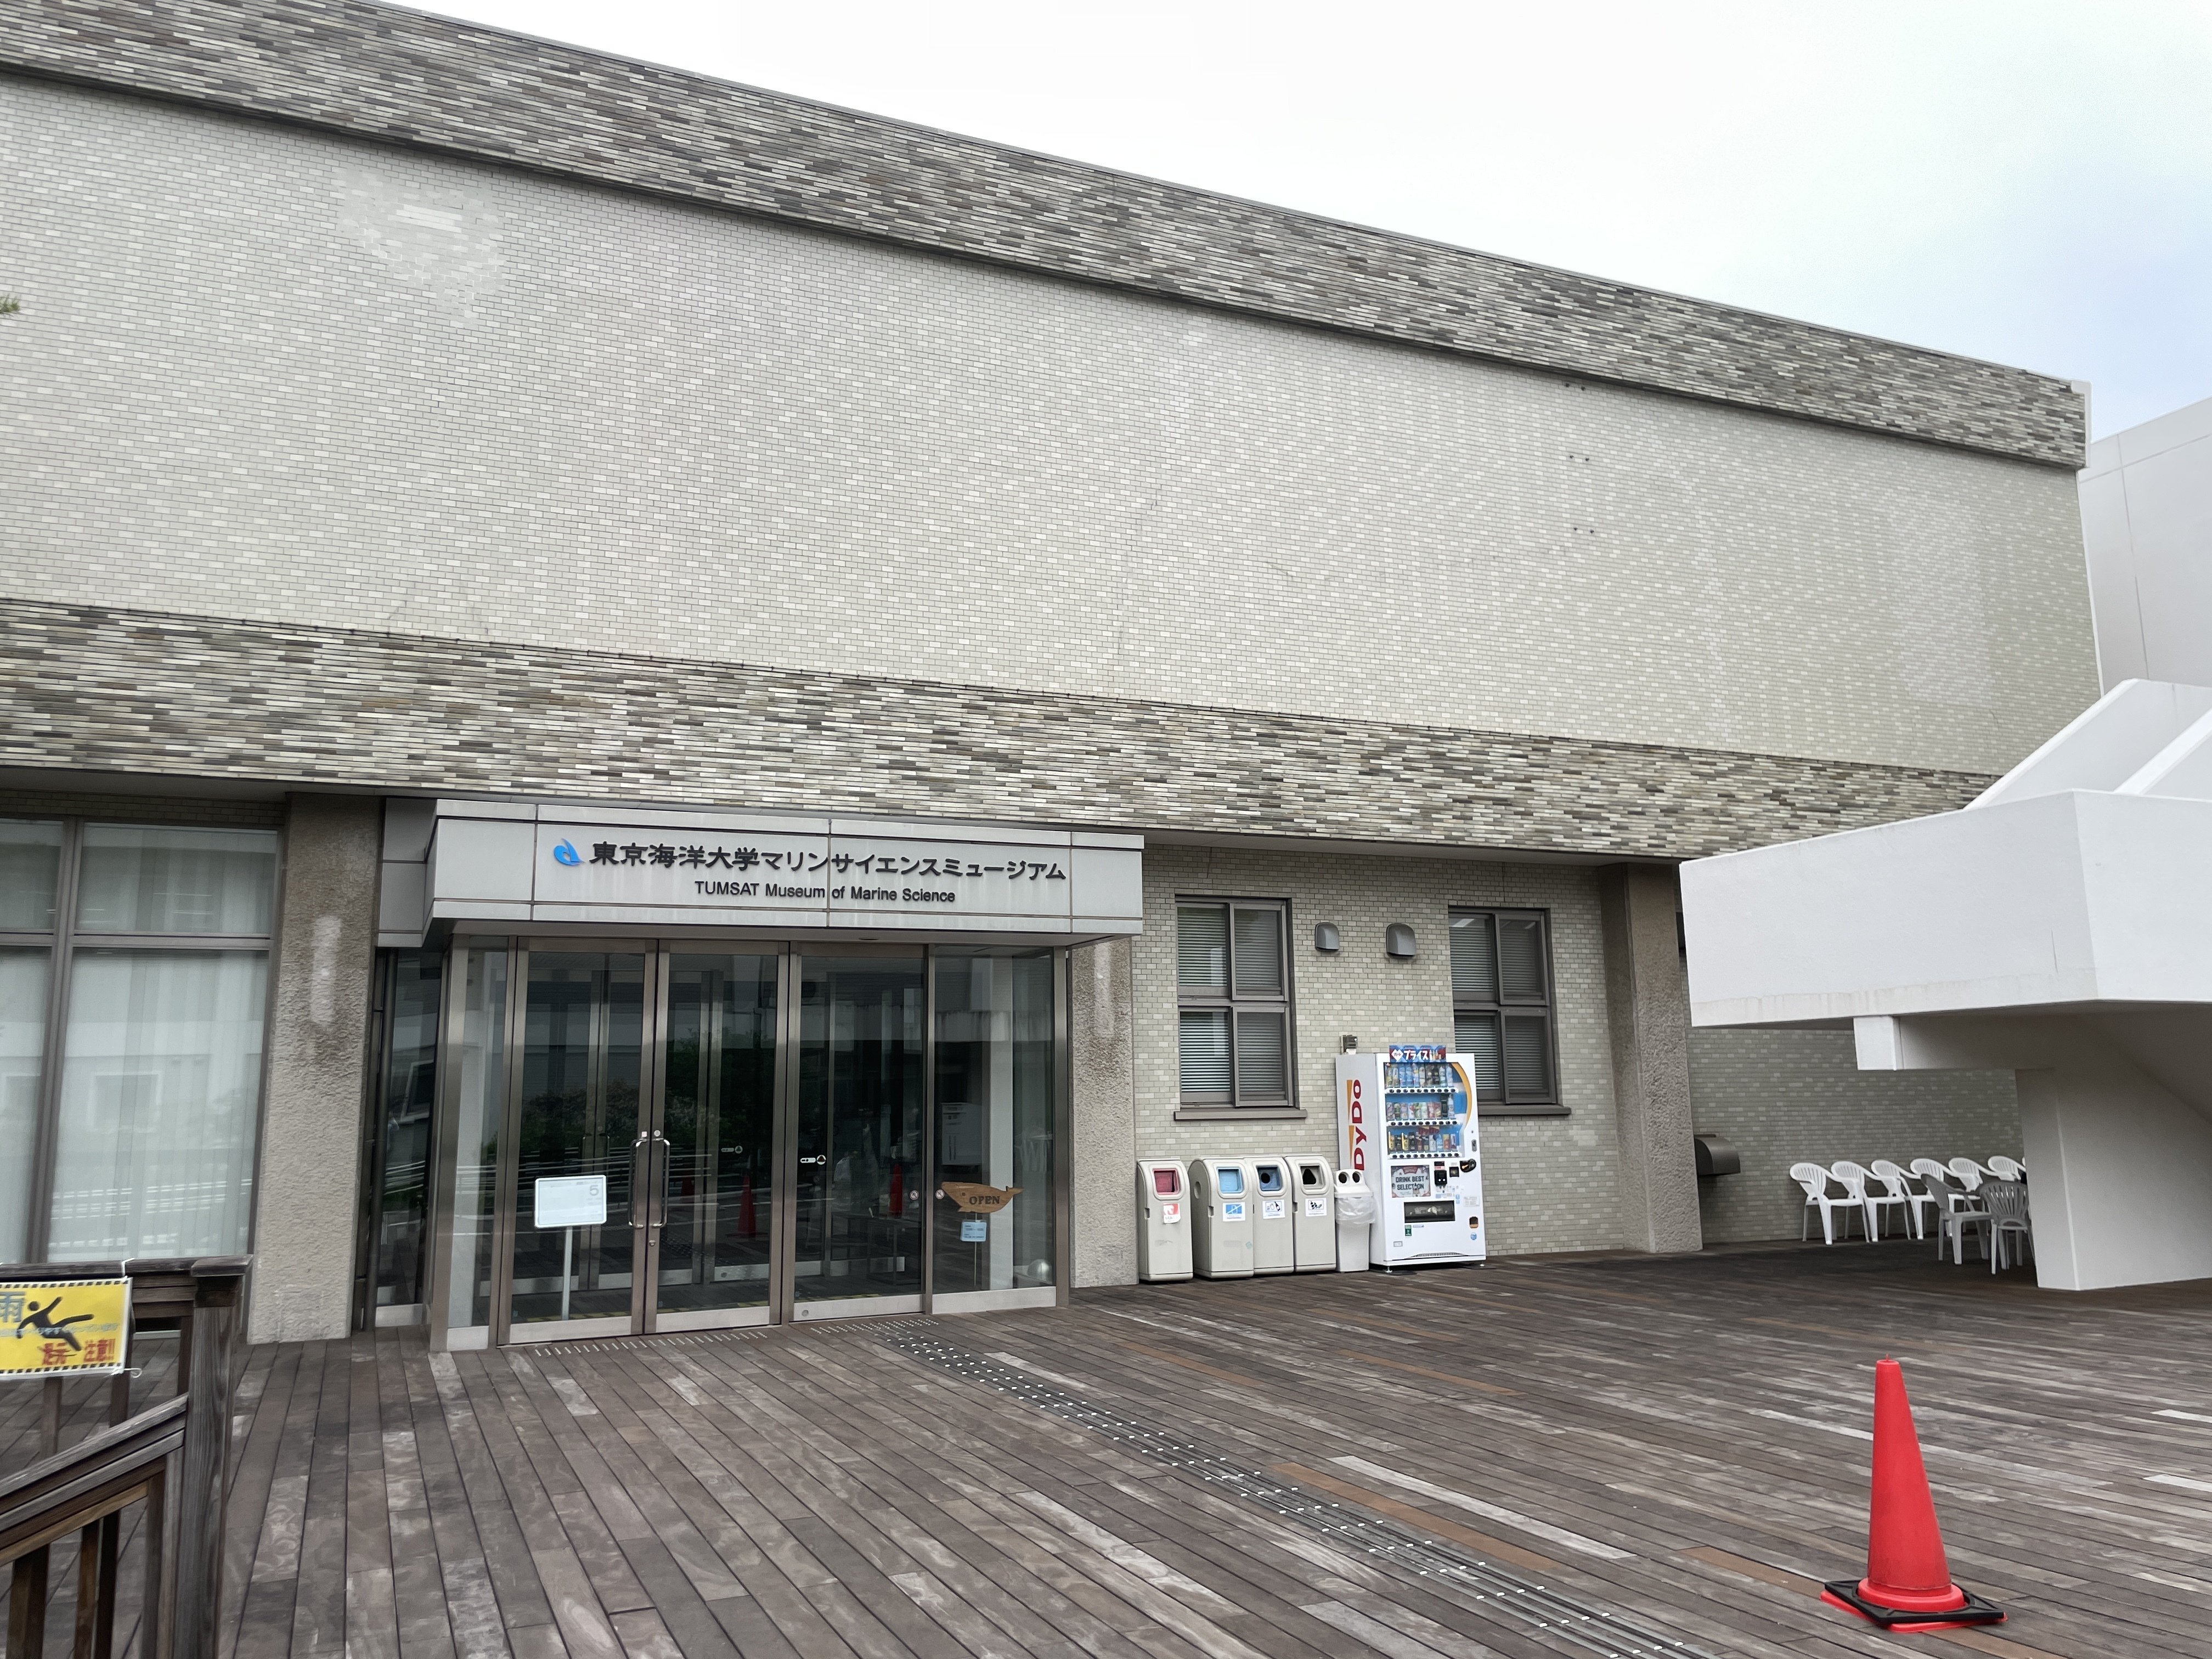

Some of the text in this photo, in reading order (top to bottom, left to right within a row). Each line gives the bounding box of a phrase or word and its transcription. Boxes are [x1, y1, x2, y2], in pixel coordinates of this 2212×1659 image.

[589, 841, 1066, 880] 東京海洋大学マリンサイエンスミュージアム
[695, 881, 955, 902] TUMSAT Museum of Marine Science
[589, 1184, 600, 1196] 5
[969, 1195, 1001, 1205] OPEN
